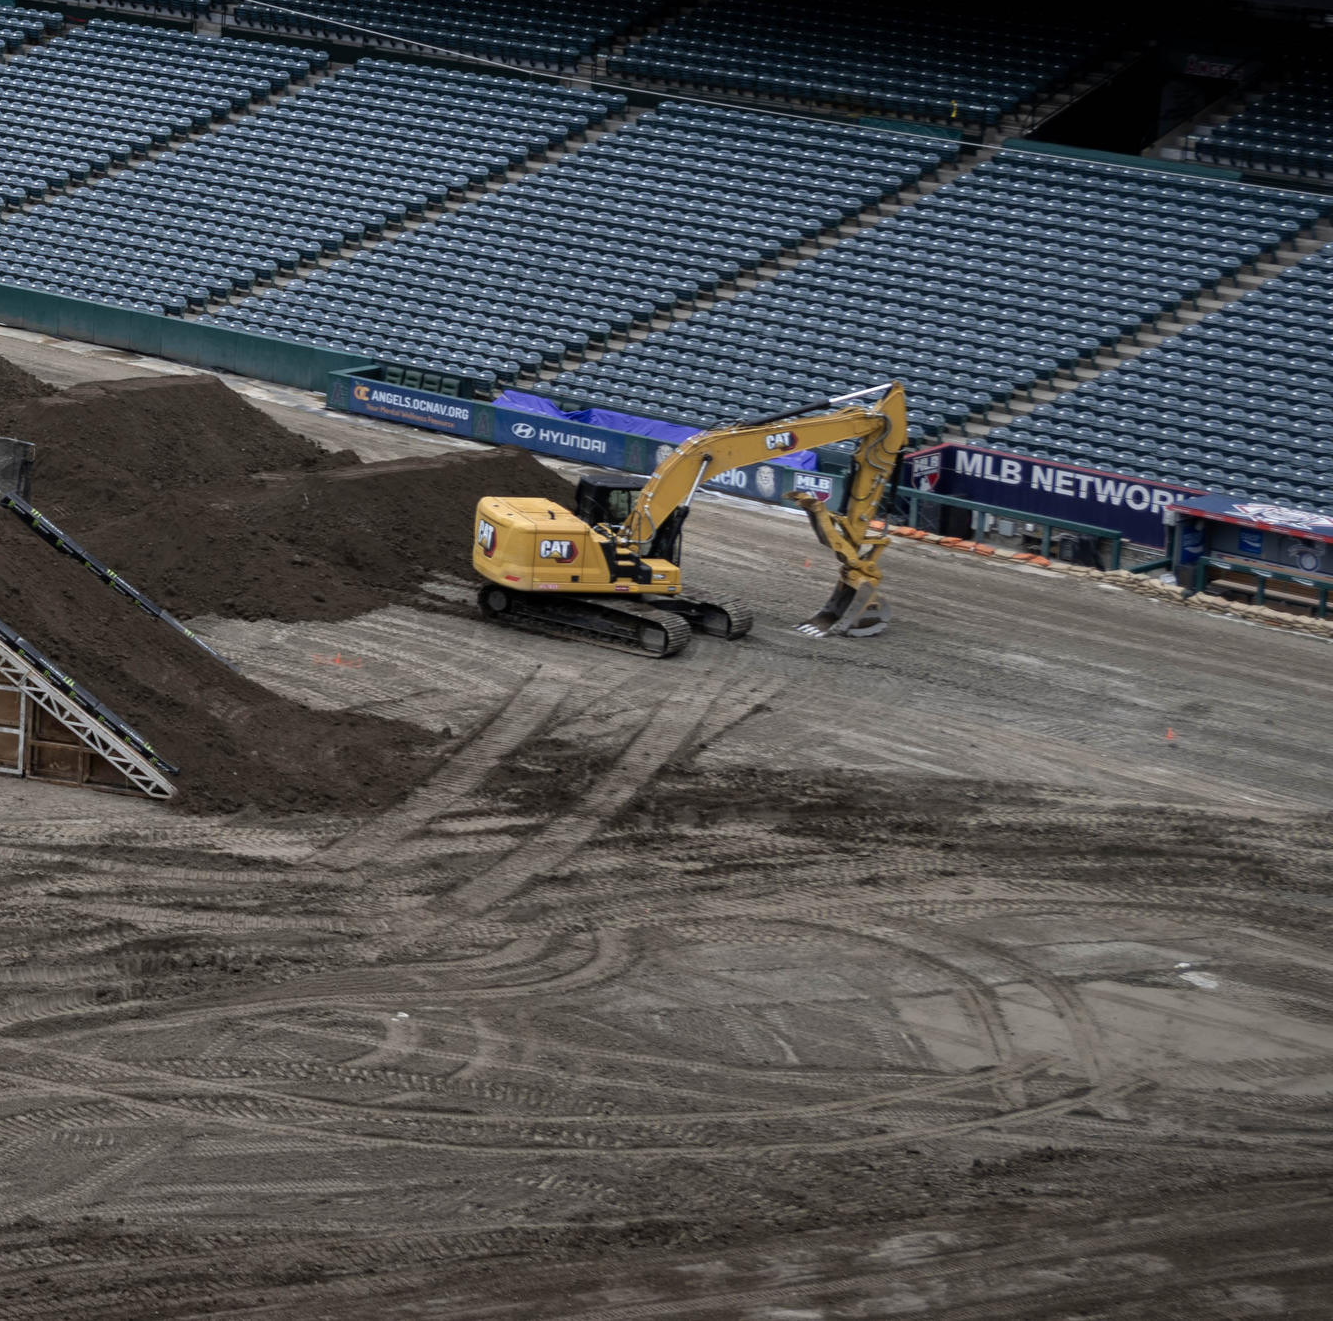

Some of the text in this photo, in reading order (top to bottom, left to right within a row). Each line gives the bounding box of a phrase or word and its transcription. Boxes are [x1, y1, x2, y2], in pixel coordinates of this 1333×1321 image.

[371, 390, 469, 420] ANGELS.OCNAV.ORG
[539, 429, 606, 454] HYUNDAI
[766, 432, 790, 450] CAT
[955, 450, 1022, 485] MLB
[797, 474, 831, 490] MLB
[477, 520, 494, 550] CAT
[540, 541, 570, 559] CAT
